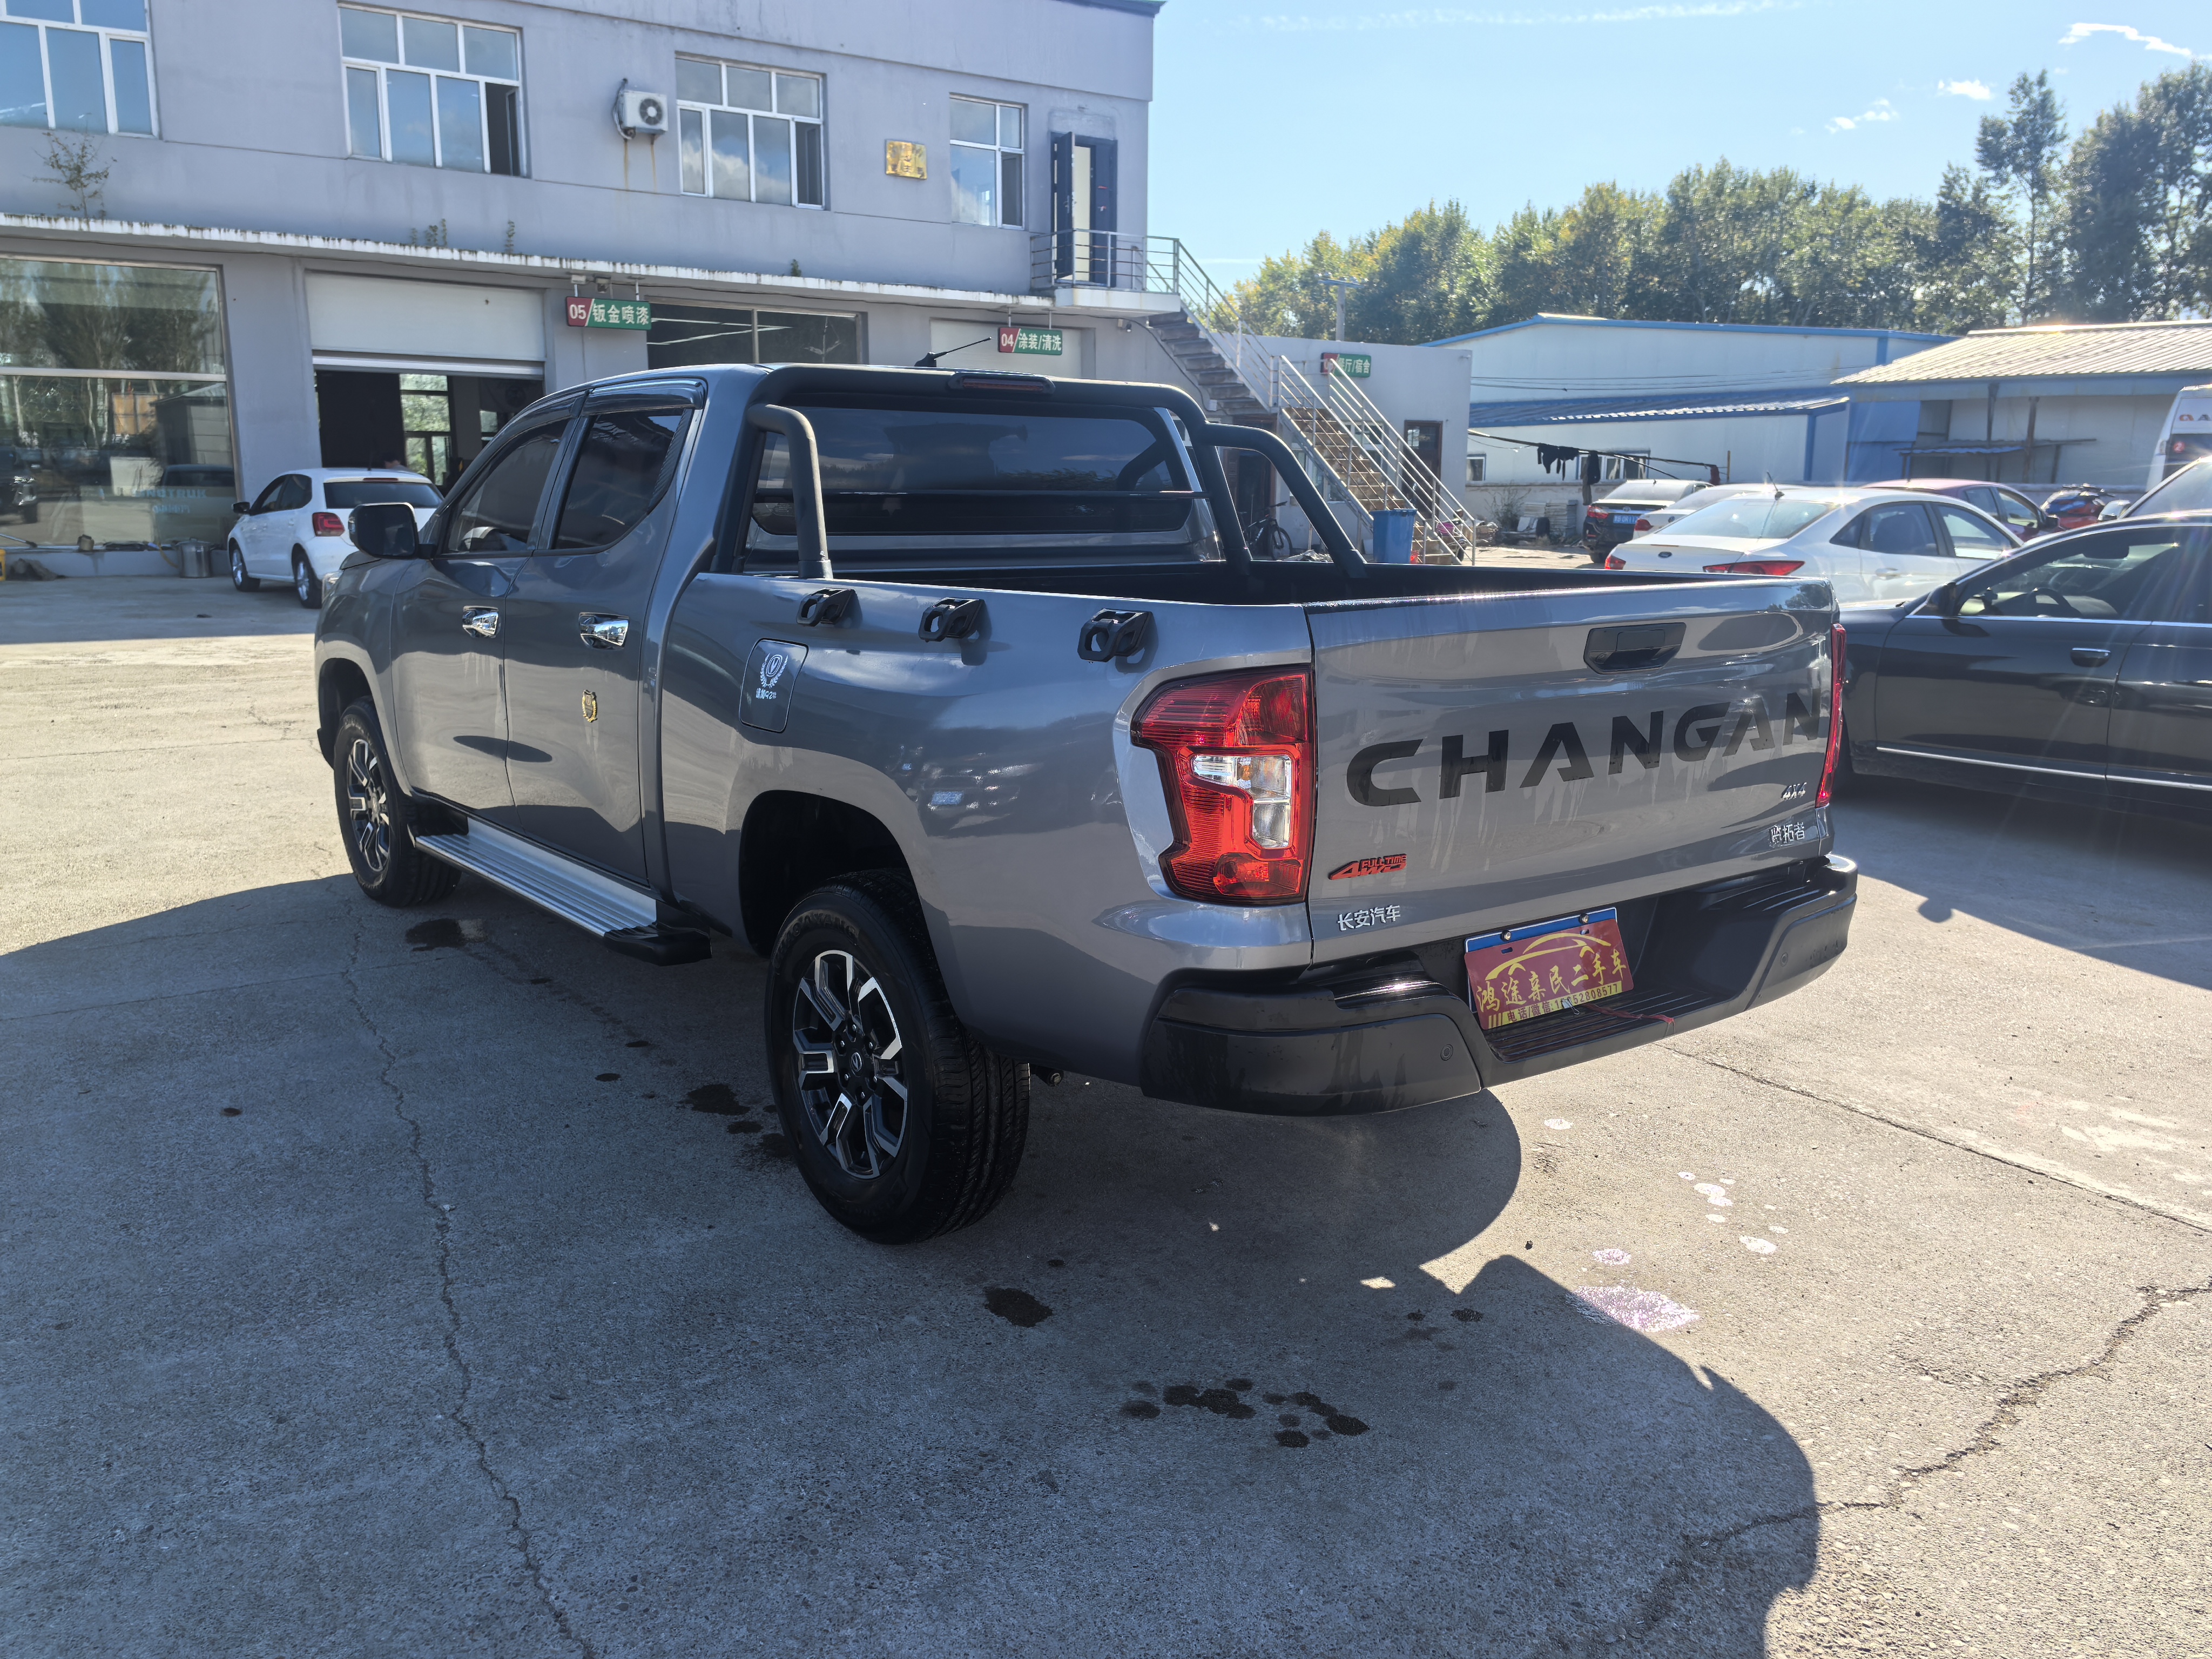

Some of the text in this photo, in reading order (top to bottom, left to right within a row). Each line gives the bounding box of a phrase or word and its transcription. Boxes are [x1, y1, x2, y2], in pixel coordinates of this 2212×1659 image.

[569, 303, 650, 325] 05 钣金喷漆
[1001, 333, 1014, 347] 04
[1346, 687, 1822, 807] CHANGAN
[1361, 854, 1407, 868] FULL TIME
[1337, 904, 1401, 931] 长安汽车
